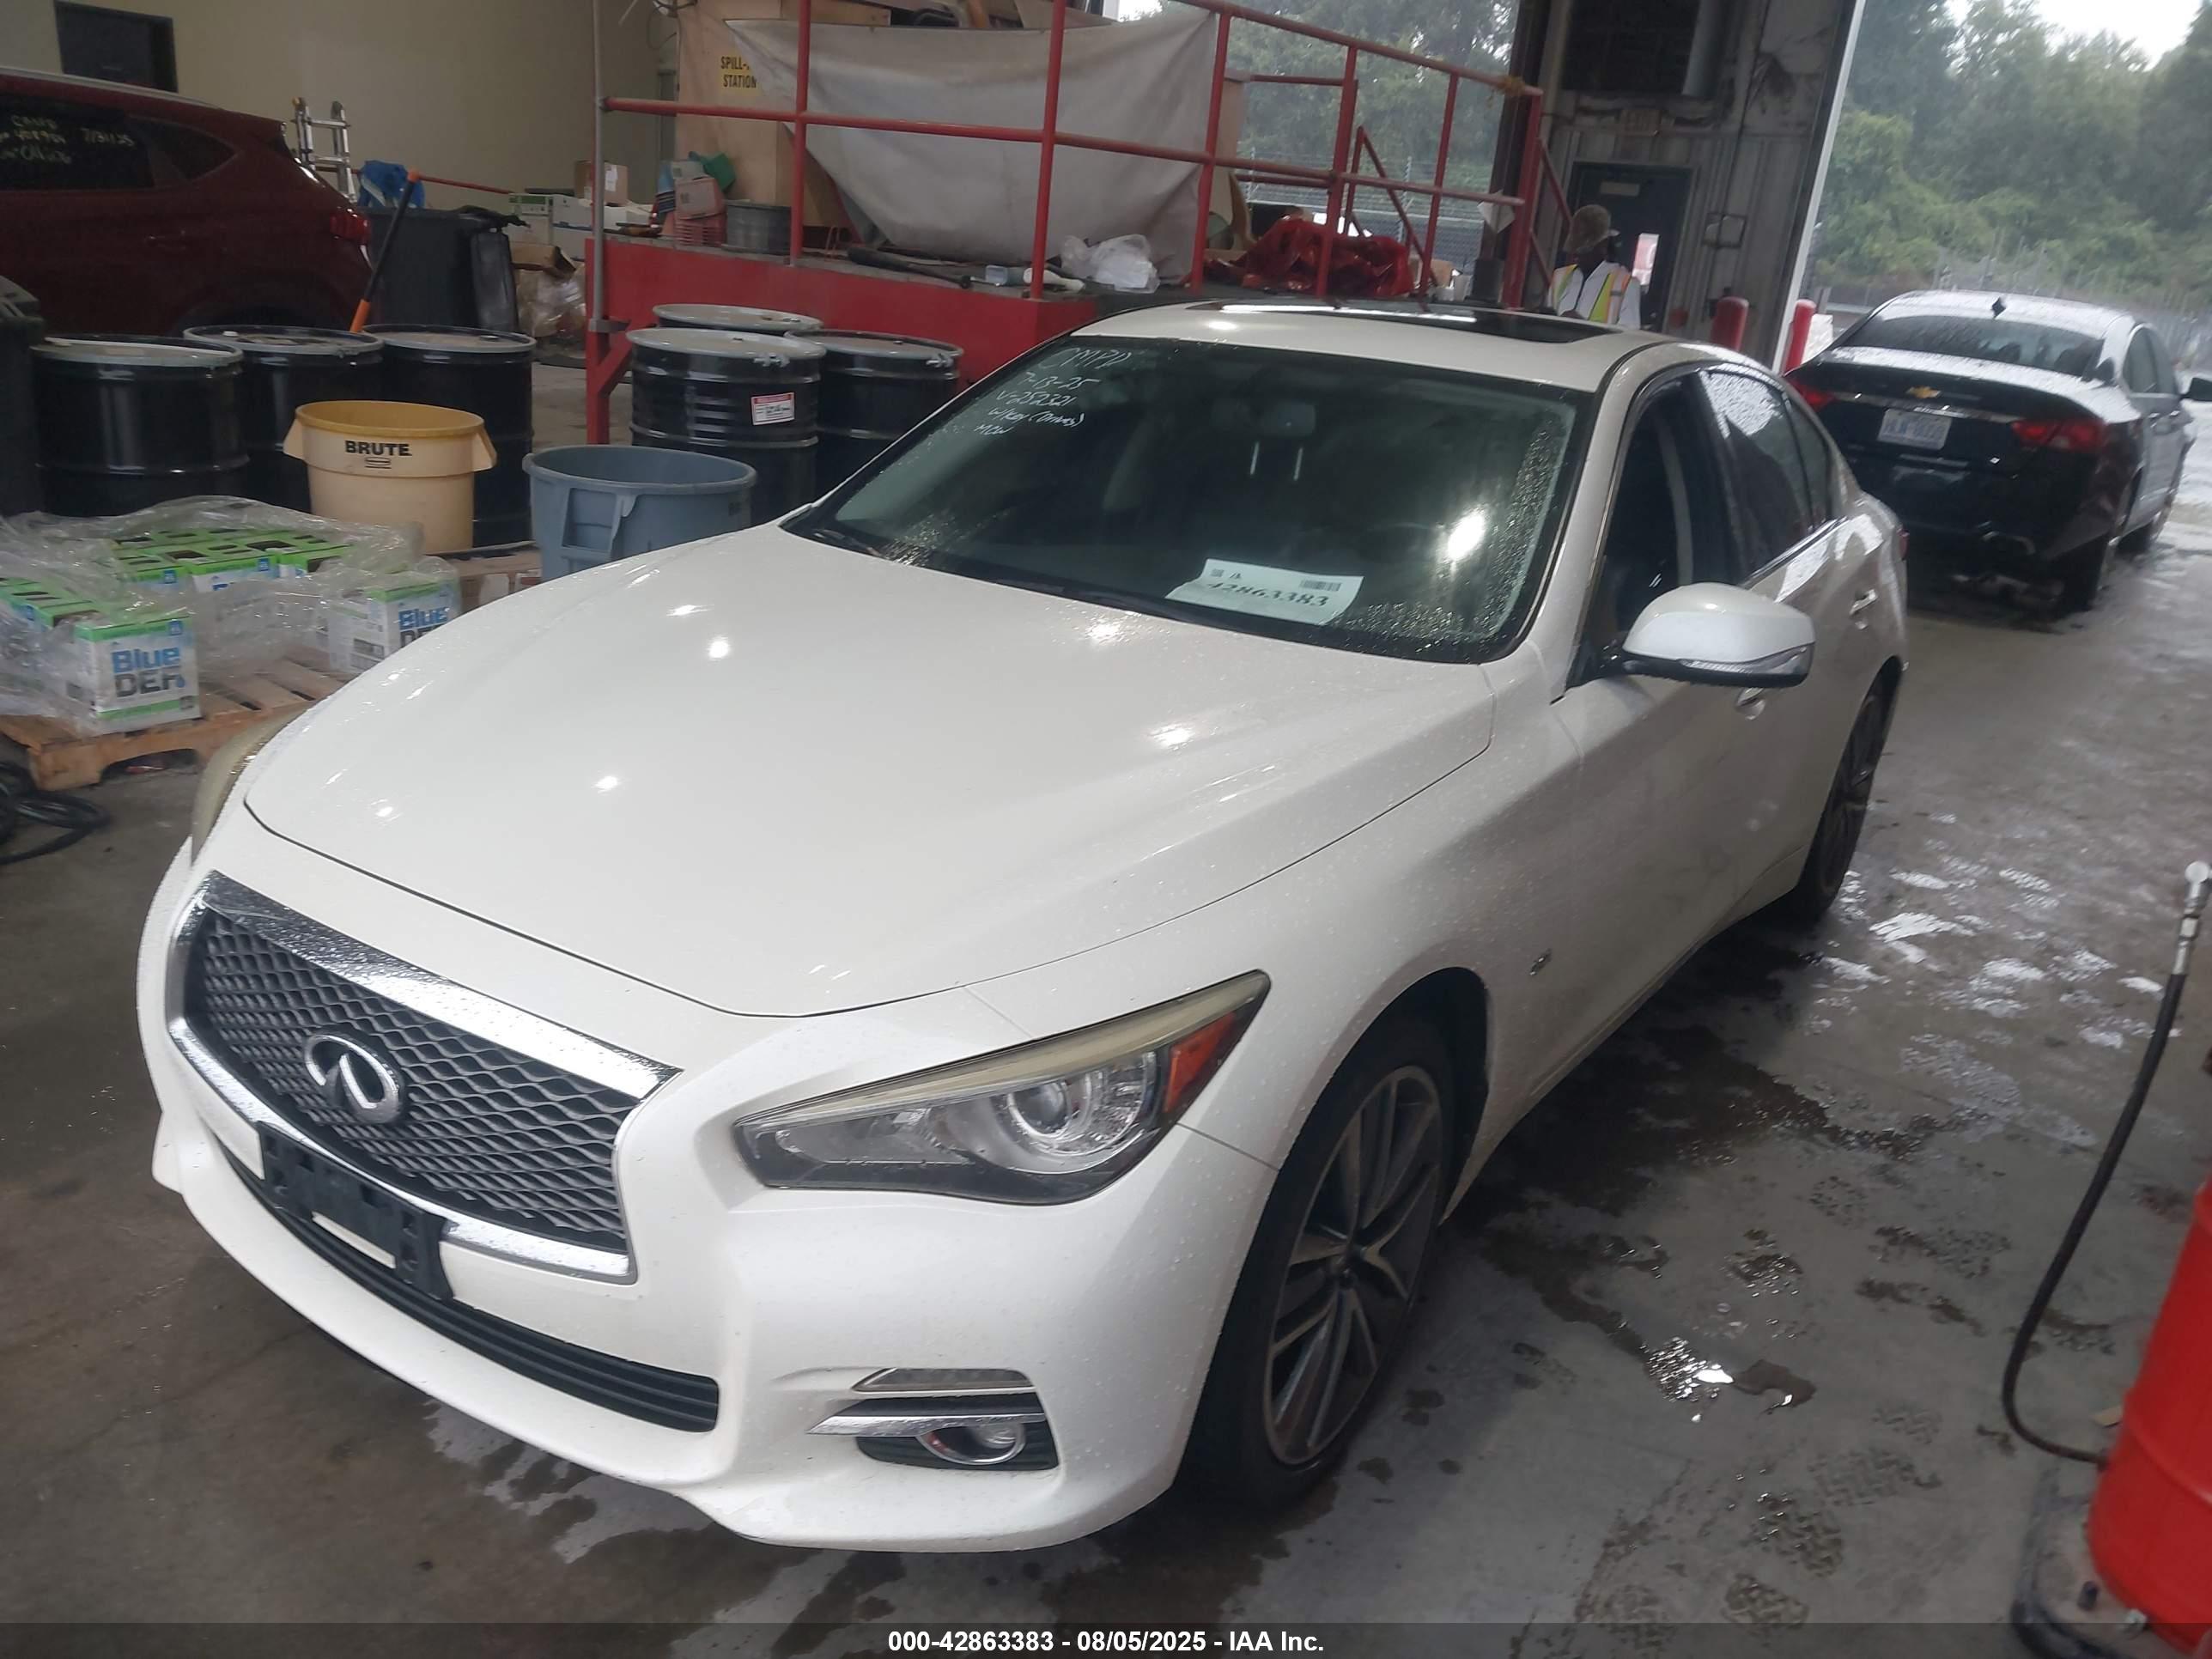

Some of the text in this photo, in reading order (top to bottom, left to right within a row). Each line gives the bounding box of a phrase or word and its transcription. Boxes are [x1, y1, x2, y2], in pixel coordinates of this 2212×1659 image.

[723, 75, 757, 88] STATION
[345, 440, 412, 457] BRUTE
[398, 607, 450, 630] Blue
[112, 647, 180, 673] Blue
